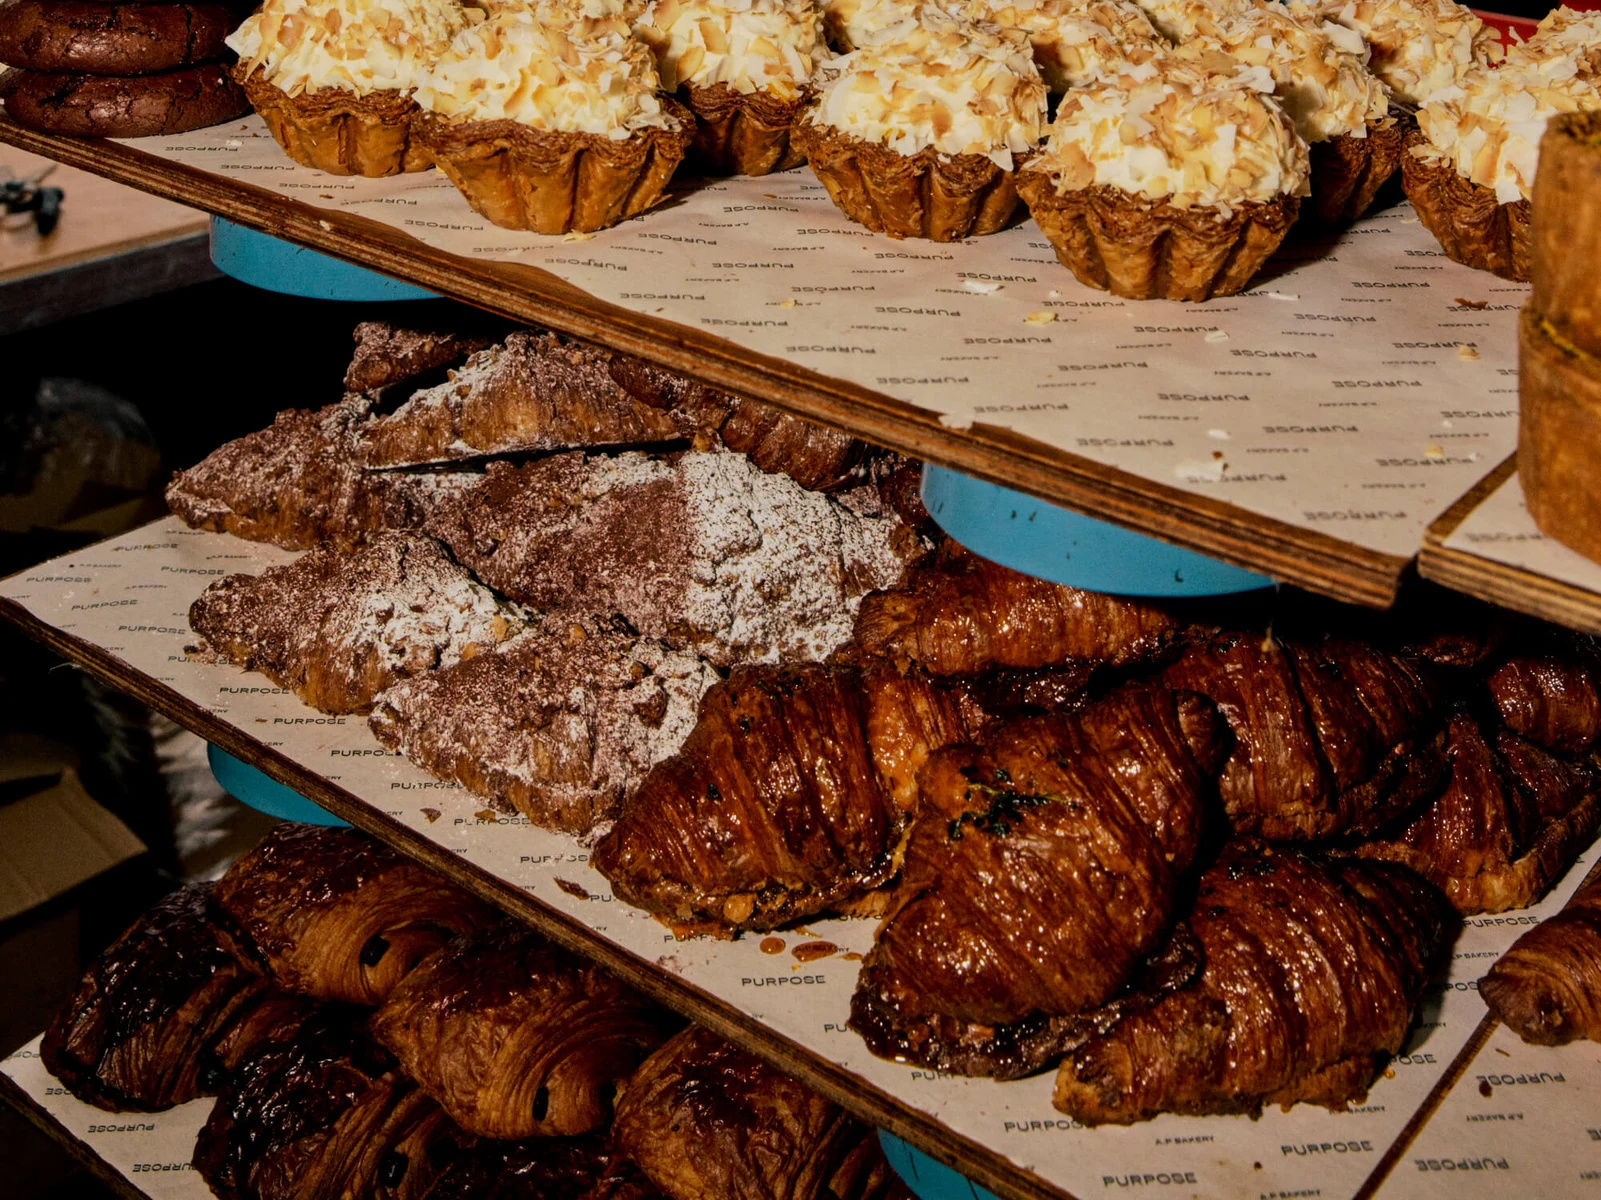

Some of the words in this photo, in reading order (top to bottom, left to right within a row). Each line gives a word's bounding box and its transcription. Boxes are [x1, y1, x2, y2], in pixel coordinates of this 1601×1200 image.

[278, 182, 355, 190] PURPOSE
[722, 204, 800, 214] PURPOSE
[404, 219, 484, 231] PURPOSE
[796, 228, 875, 238] PURPOSE
[637, 232, 718, 246] PURPOSE
[873, 252, 954, 261] PURPOSE
[544, 257, 629, 272] PURPOSE
[955, 272, 1038, 283] PURPOSE
[791, 285, 876, 295] PURPOSE
[1350, 281, 1431, 289] PURPOSE
[620, 292, 706, 301] PURPOSE
[1041, 300, 1126, 308] PURPOSE
[875, 306, 961, 317] PURPOSE
[700, 318, 789, 327] PURPOSE
[1293, 313, 1377, 323] PURPOSE
[1133, 325, 1219, 333] PURPOSE
[963, 336, 1053, 345] PURPOSE
[786, 345, 877, 355] PURPOSE
[1229, 349, 1318, 359] PURPOSE
[1058, 361, 1149, 372] PURPOSE
[876, 376, 970, 385] PURPOSE
[1331, 380, 1422, 388] PURPOSE
[1157, 392, 1251, 402] PURPOSE
[973, 403, 1069, 413] PURPOSE
[160, 565, 225, 576] PURPOSE
[71, 599, 138, 611] PURPOSE
[117, 625, 187, 635] PURPOSE
[219, 686, 290, 695] PURPOSE
[273, 717, 347, 725] PURPOSE
[1462, 915, 1540, 928] PURPOSE
[1464, 951, 1500, 960] BAKERY
[741, 974, 827, 987] PURPOSE
[1475, 1071, 1567, 1086] PURPOSE
[86, 1122, 156, 1134] PURPOSE
[1280, 1140, 1374, 1157] PURPOSE
[131, 1161, 194, 1173] URPOSE
[1414, 1156, 1511, 1172] PURPOSE
[1101, 1171, 1198, 1188] PURPOSE
